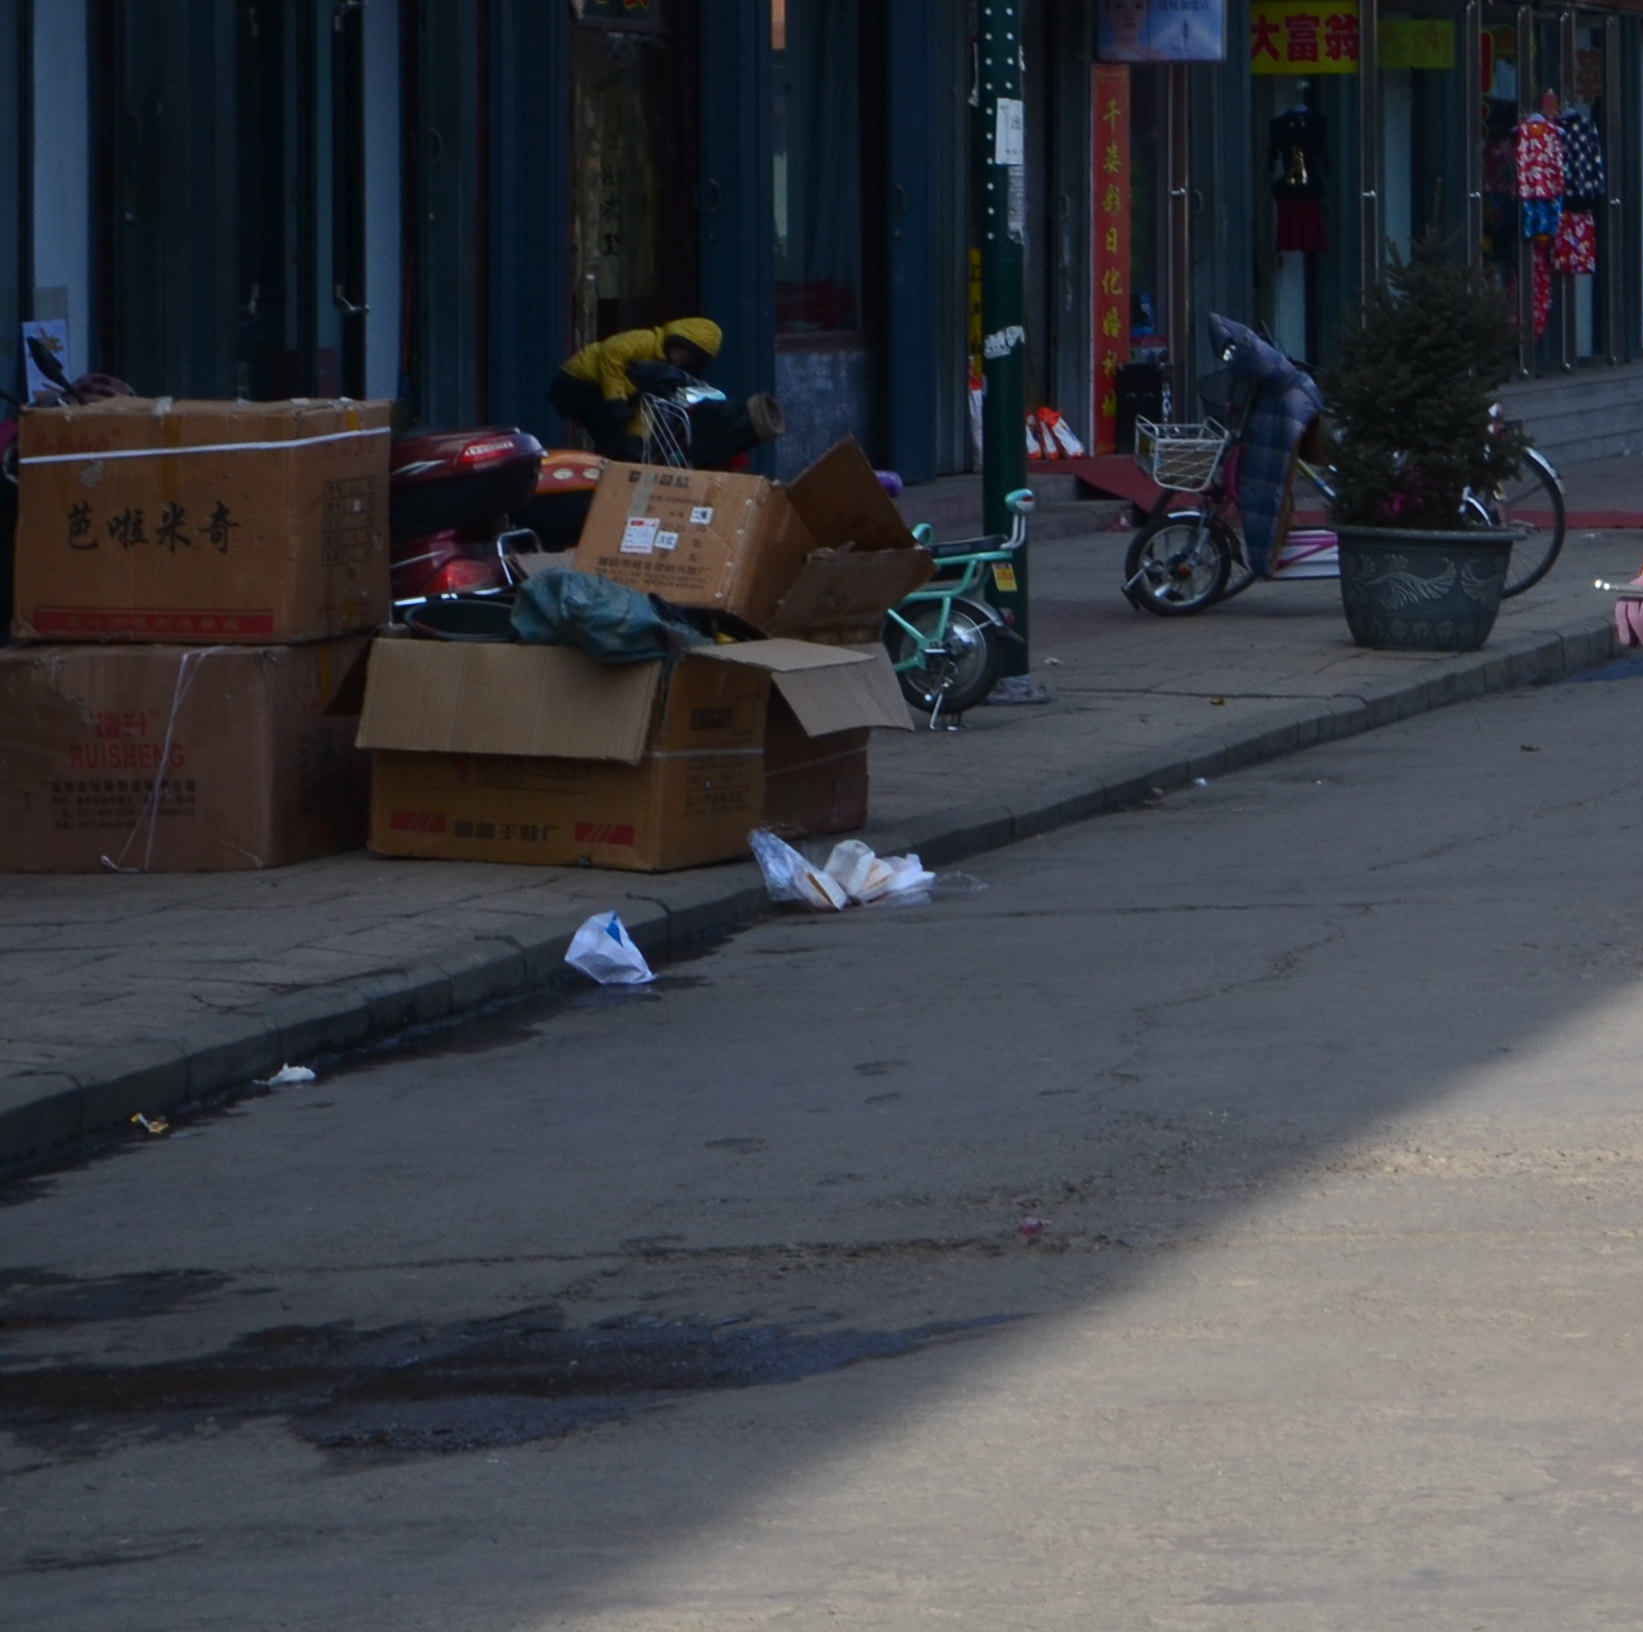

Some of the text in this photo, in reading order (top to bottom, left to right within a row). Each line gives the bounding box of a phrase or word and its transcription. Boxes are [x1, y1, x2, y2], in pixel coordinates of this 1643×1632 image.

[1251, 14, 1360, 64] 大富翁
[70, 743, 186, 770] RUISHENG
